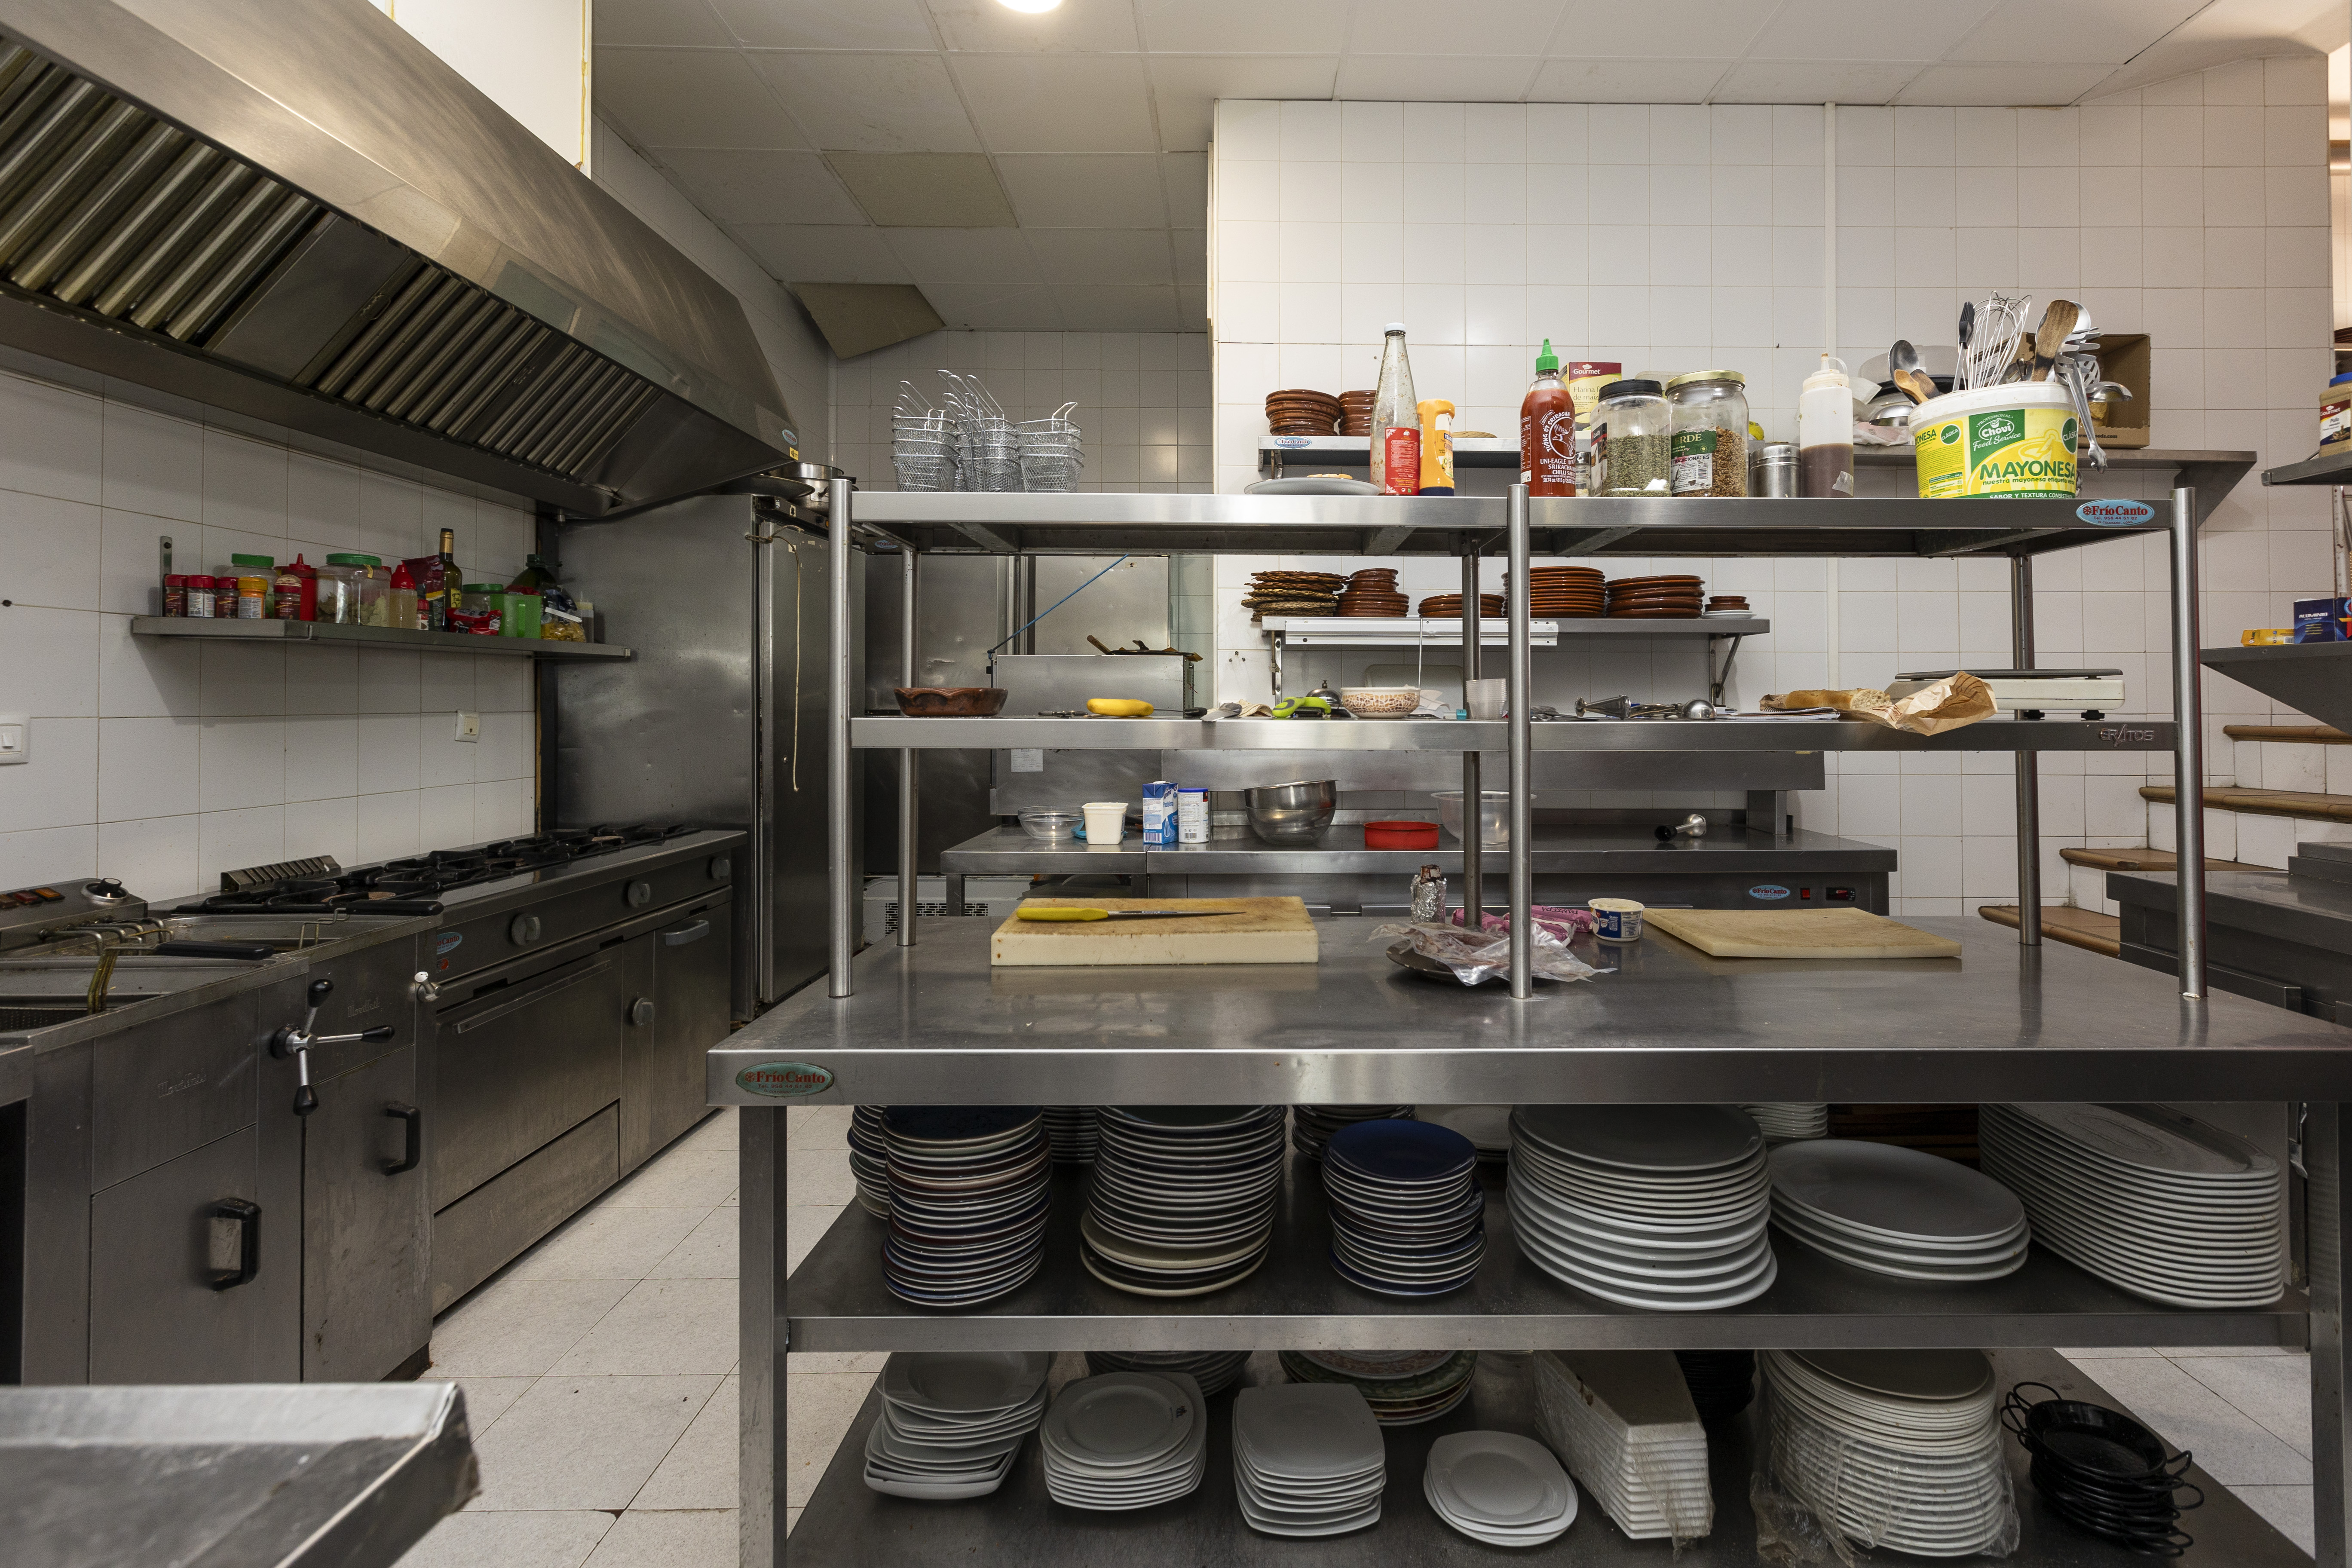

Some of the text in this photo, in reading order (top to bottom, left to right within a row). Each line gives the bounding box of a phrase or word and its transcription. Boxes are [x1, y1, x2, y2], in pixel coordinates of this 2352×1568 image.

[1548, 411, 1570, 425] SRIRACHA
[1977, 413, 2011, 426] PROFESSIONAL
[1915, 429, 1937, 444] ONESA
[1941, 429, 1959, 440] CLÁSICA
[2063, 430, 2077, 441] CLÁSIC
[1973, 433, 2021, 451] Food Service
[1672, 455, 1710, 464] TRADICIONAES
[1979, 460, 2075, 480] MAYONESA
